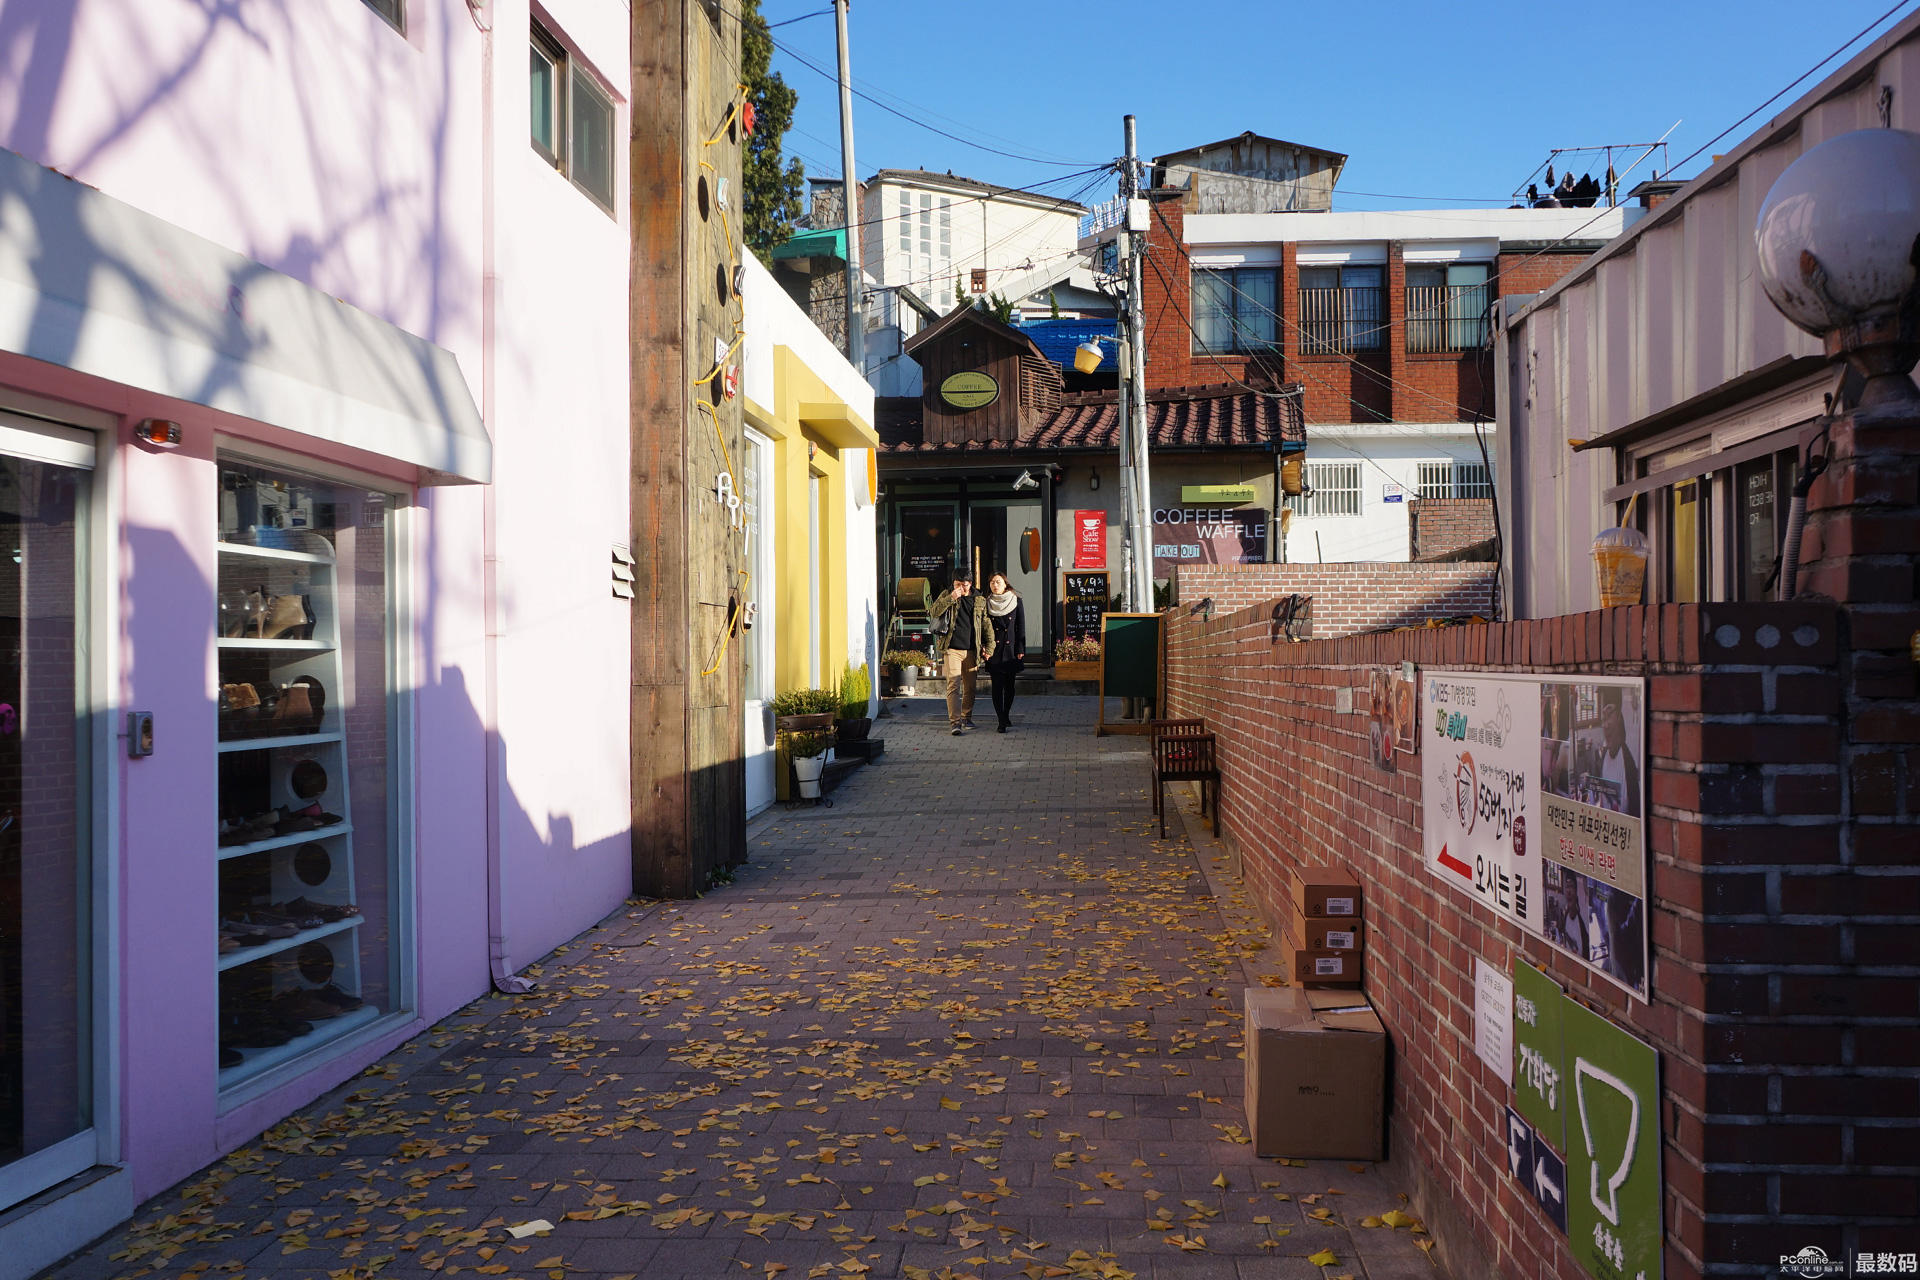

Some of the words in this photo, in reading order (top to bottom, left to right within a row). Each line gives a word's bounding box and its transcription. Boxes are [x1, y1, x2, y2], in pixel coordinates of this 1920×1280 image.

[1153, 508, 1234, 525] COFFEE
[1195, 524, 1265, 539] WAFFLE
[1154, 544, 1178, 558] TAKE
[1180, 544, 1200, 558] OUT
[1478, 781, 1512, 841] 55번지
[1505, 769, 1525, 813] 라면
[1547, 804, 1575, 833] 대한민국
[1578, 814, 1632, 851] 대표맛집선정!
[1559, 837, 1575, 864] 한옥
[1578, 844, 1595, 873] 이색
[1598, 850, 1617, 881] 라면
[1475, 854, 1510, 910] 오시는
[1514, 873, 1527, 920] 길
